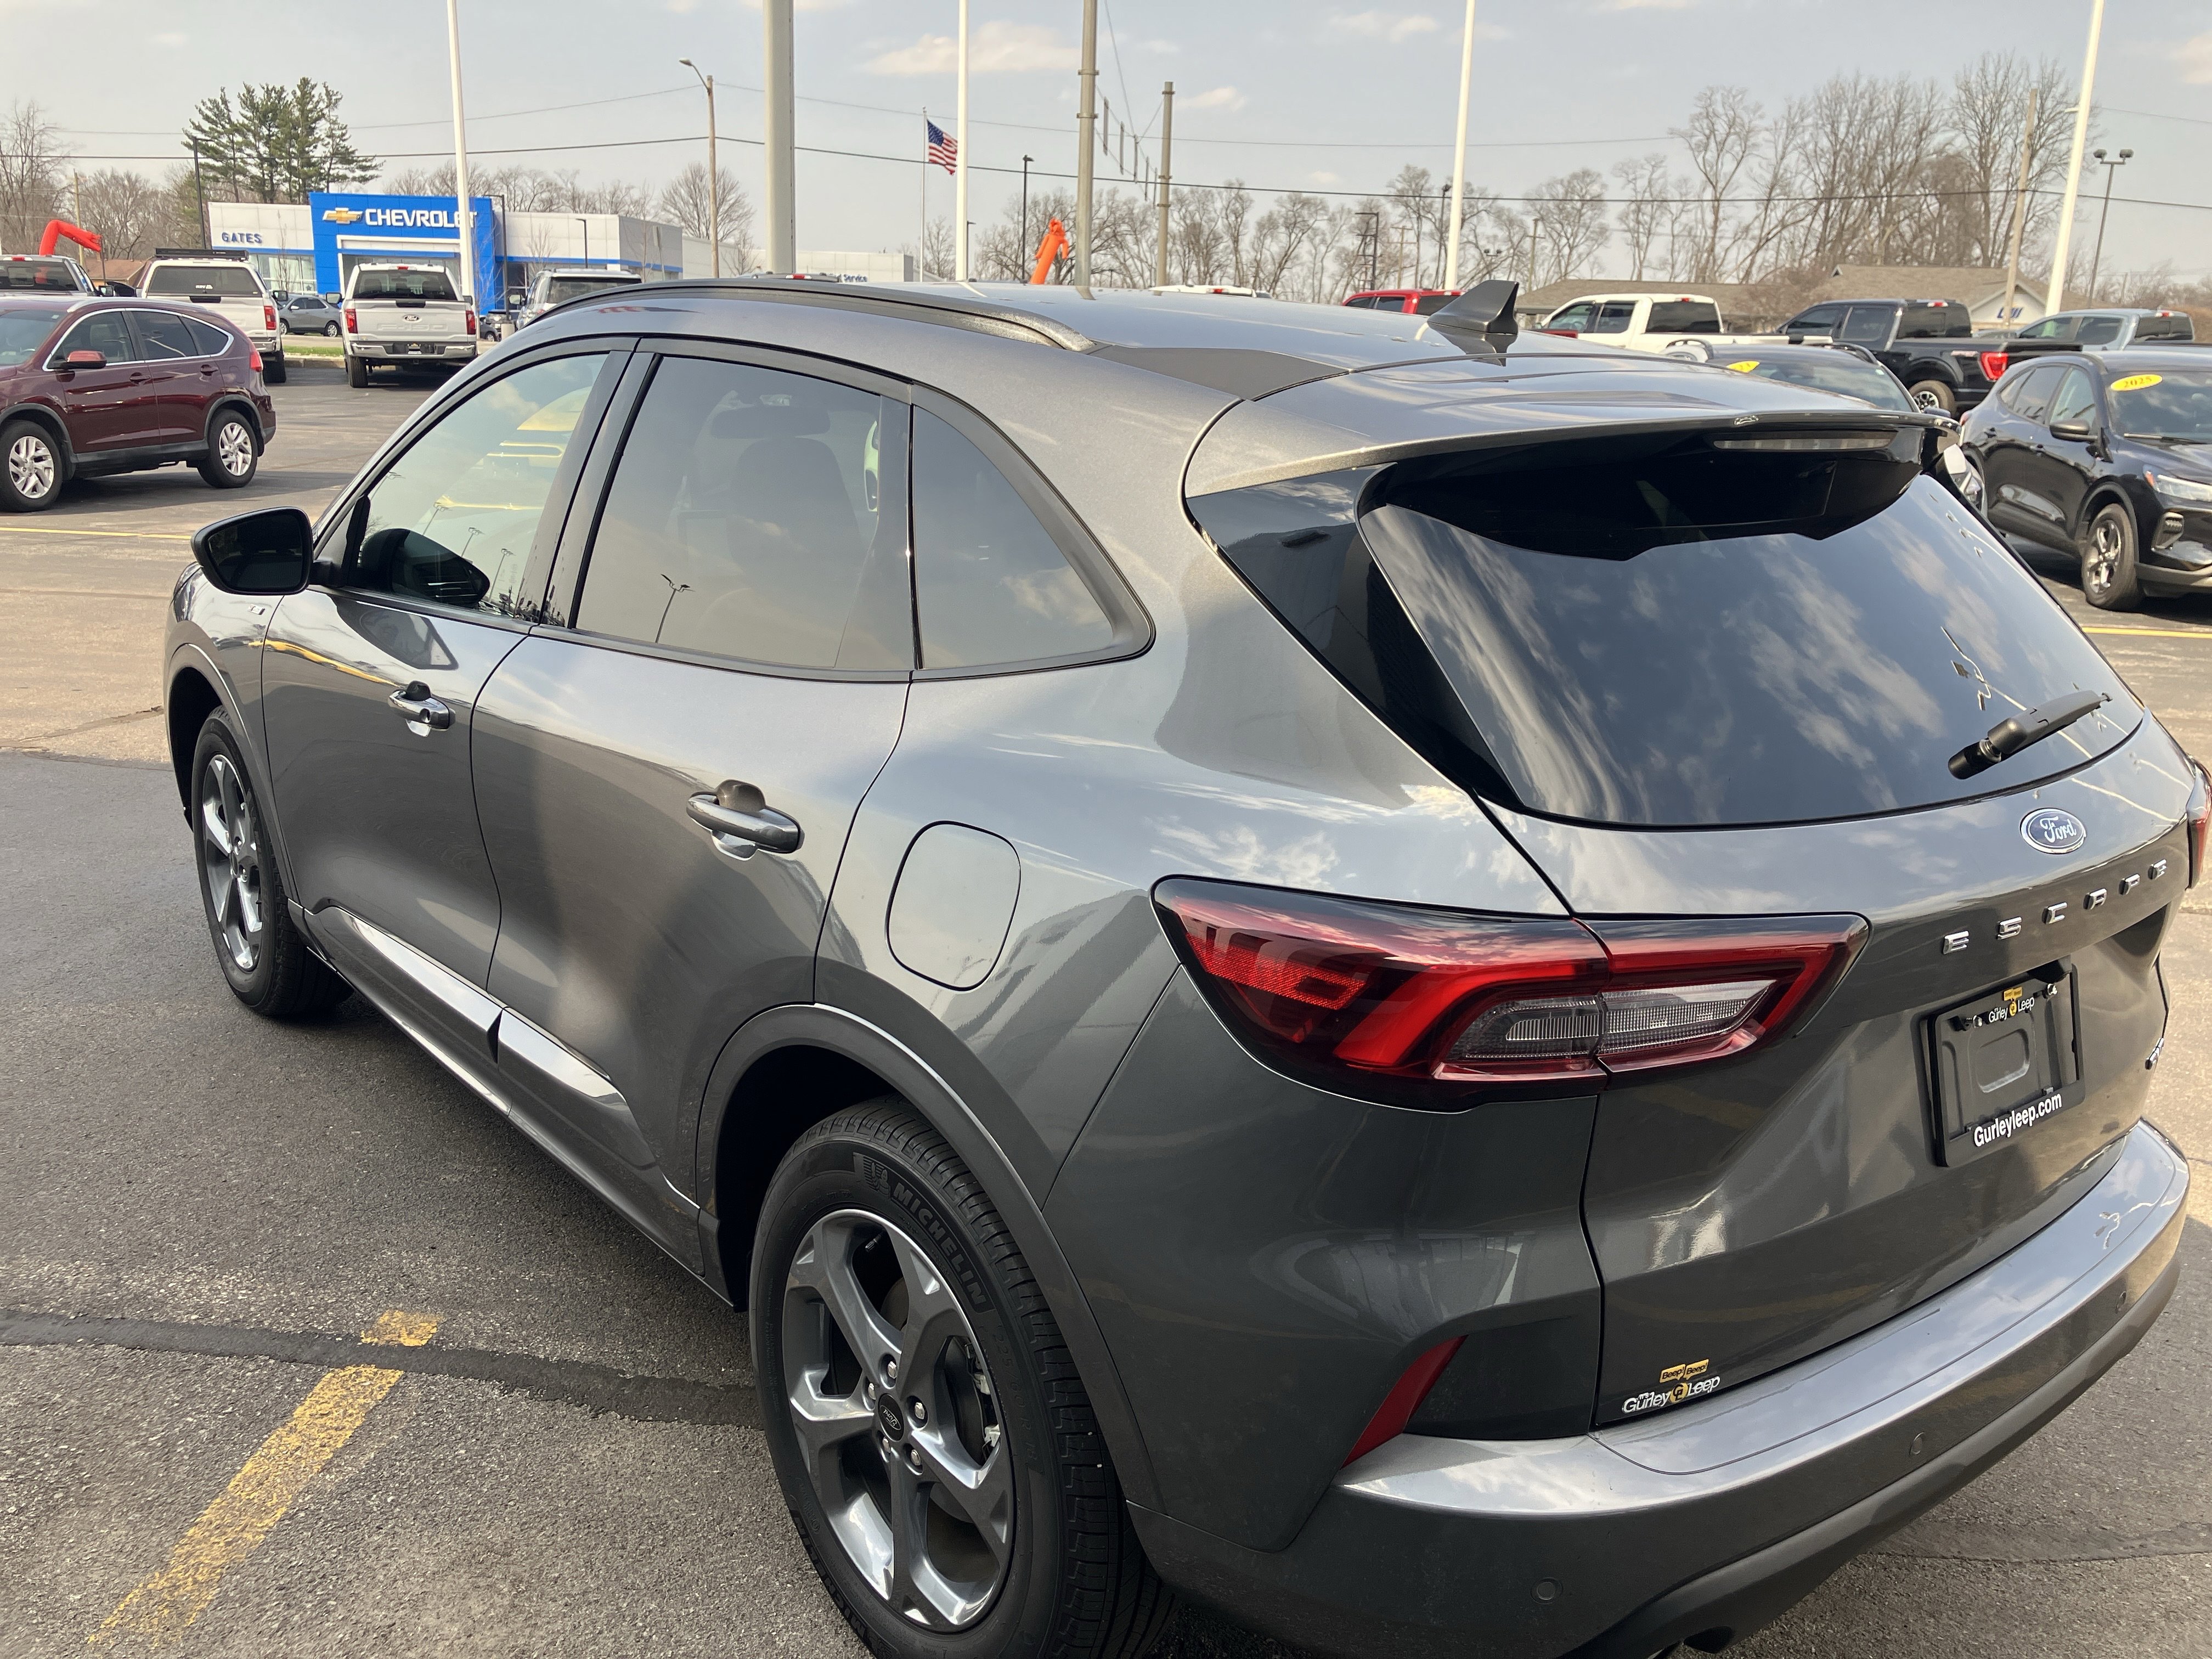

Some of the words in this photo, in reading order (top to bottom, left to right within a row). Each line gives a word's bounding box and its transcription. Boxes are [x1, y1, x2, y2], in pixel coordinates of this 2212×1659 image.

[222, 232, 262, 244] GATES
[2124, 376, 2152, 388] 2025
[2040, 816, 2076, 843] Ford
[1942, 859, 2168, 955] ESCAPE
[1989, 1007, 2008, 1023] Gurley
[2018, 997, 2035, 1012] Leep
[1974, 1093, 2062, 1147] Gurleyleep.com
[893, 1182, 988, 1305] MICHELIN
[992, 1333, 1027, 1409] 225/60
[1662, 1366, 1685, 1380] Beep!
[1686, 1362, 1708, 1375] Beep!
[1623, 1392, 1672, 1413] Gurley
[1687, 1375, 1721, 1397] Leep
[883, 1409, 898, 1427] Ford
